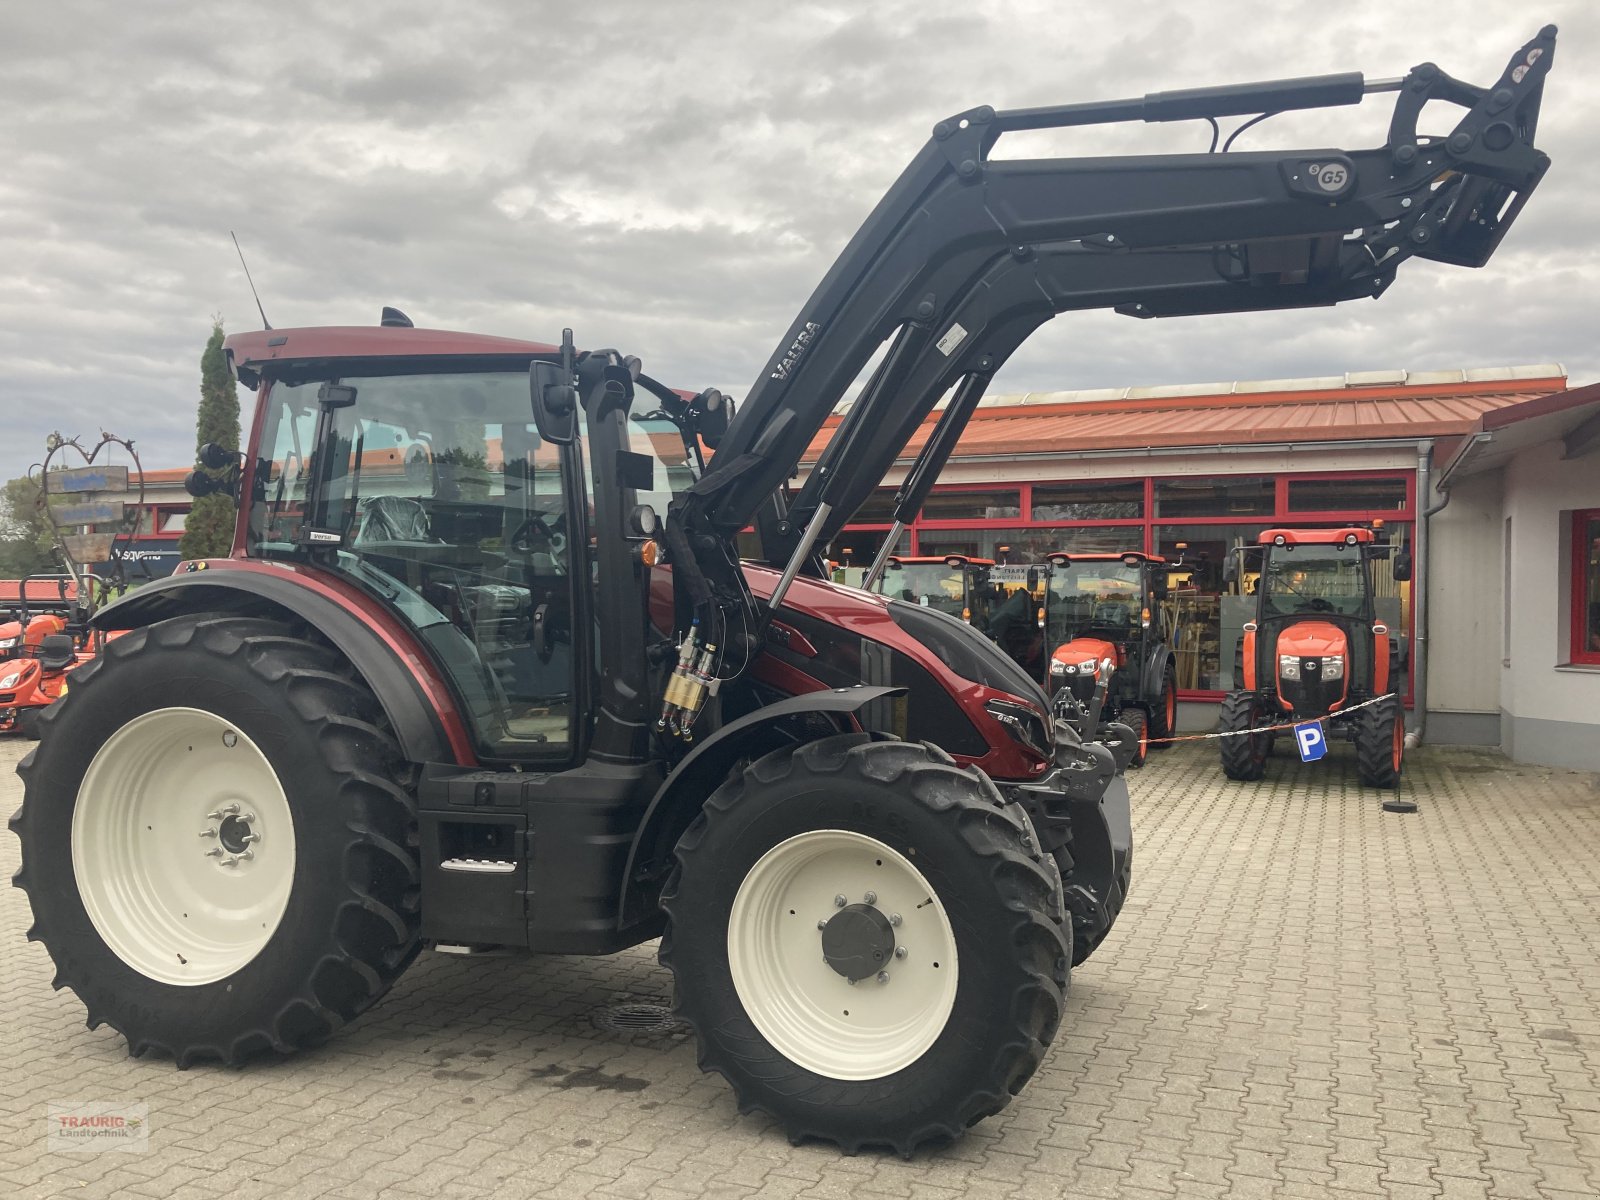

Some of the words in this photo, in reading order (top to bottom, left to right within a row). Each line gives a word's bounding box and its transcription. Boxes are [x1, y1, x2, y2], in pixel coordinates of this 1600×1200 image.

[1321, 171, 1345, 184] G5
[771, 321, 820, 380] VALTRA
[1298, 728, 1321, 756] P
